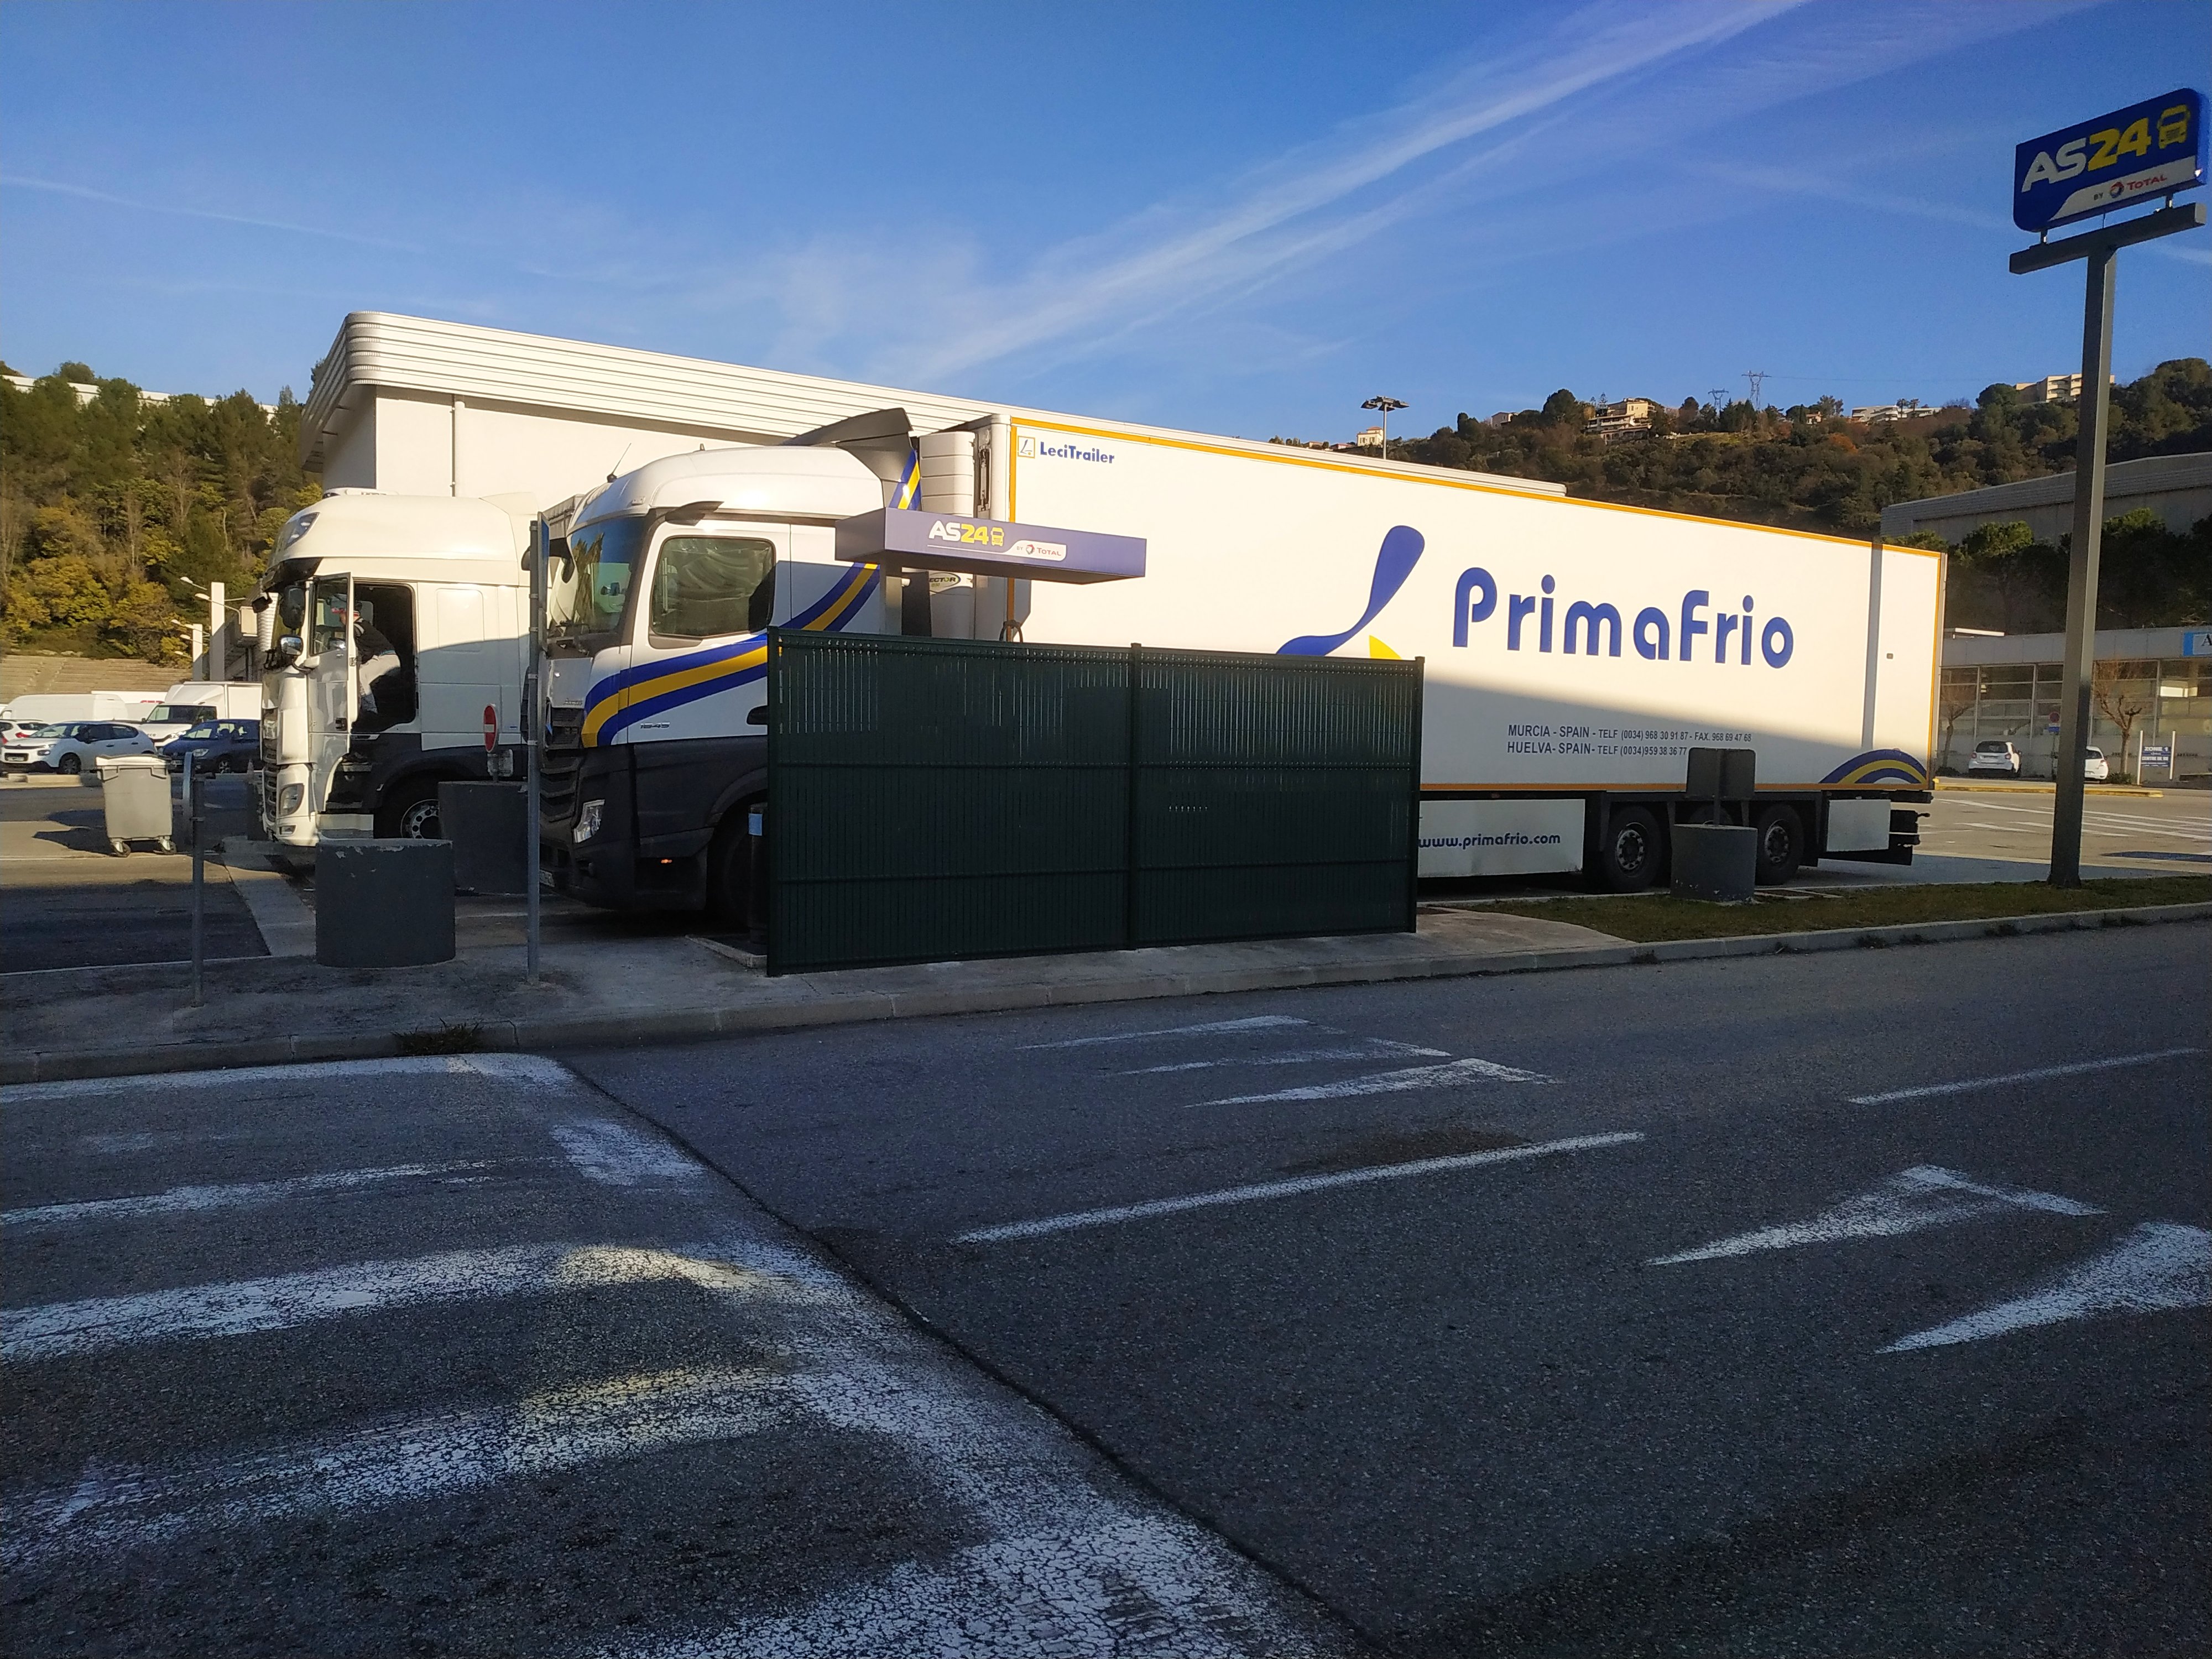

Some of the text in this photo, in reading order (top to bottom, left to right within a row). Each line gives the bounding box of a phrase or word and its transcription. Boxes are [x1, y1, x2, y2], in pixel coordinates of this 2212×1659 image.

[2021, 117, 2152, 193] AS24
[2093, 174, 2167, 200] BY TOTAL
[1040, 441, 1115, 464] LeciTrailer
[928, 520, 989, 545] AS24
[1036, 547, 1062, 556] TOTAL
[1508, 724, 1551, 737] MURCIA
[1559, 726, 1589, 738] SPAIN
[1598, 729, 1619, 739] TELF
[1621, 729, 1644, 742] (0034)
[1645, 731, 1658, 740] 968
[1660, 731, 1668, 740] 30
[1670, 731, 1678, 740] 91
[1680, 732, 1688, 741] 87
[1712, 733, 1724, 742] 968
[1725, 733, 1733, 742] 69
[1735, 733, 1742, 742] 47
[1598, 745, 1619, 755] TELF
[1659, 747, 1667, 755] 38
[1669, 747, 1677, 756] 36
[1679, 747, 1687, 756] 77
[1418, 832, 1561, 849] www.primafrio.com
